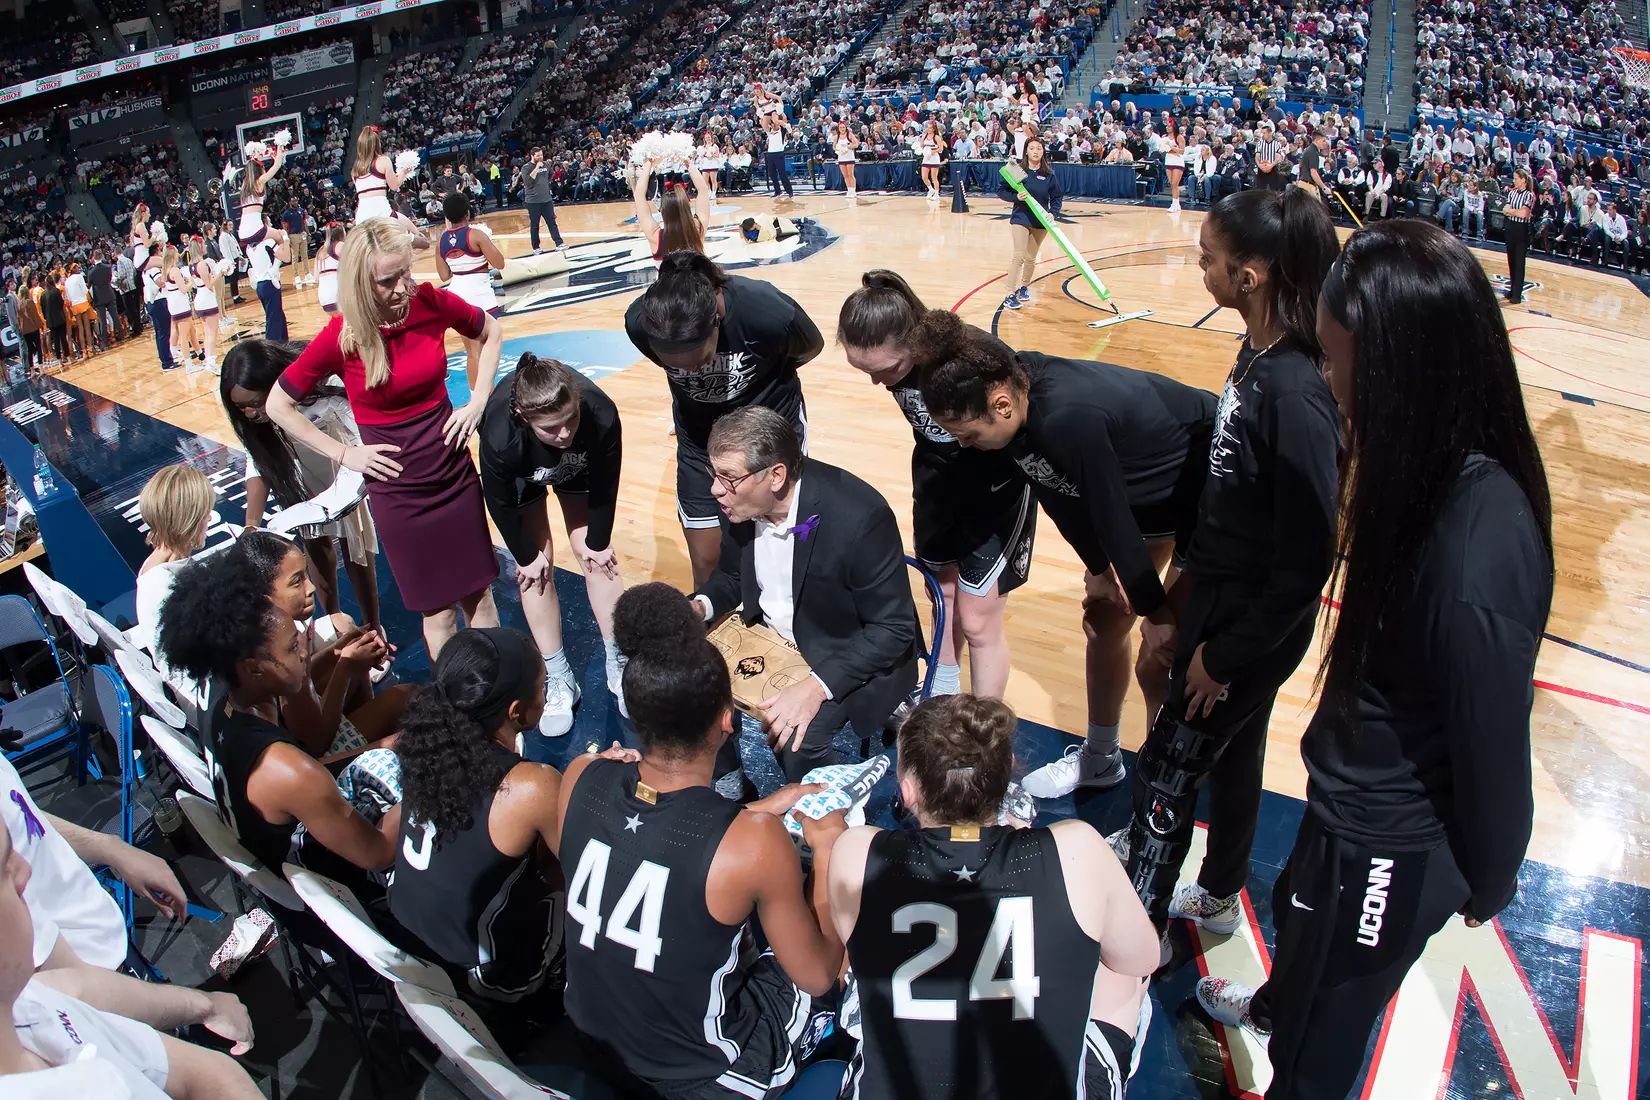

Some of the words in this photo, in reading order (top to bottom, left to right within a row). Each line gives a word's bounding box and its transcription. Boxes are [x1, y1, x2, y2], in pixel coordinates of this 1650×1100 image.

[192, 77, 228, 93] UCONN
[252, 85, 269, 95] 4:49
[120, 97, 162, 114] HUSKIES
[251, 94, 268, 111] 20
[119, 137, 131, 145] 122
[566, 837, 671, 974] 44
[1356, 857, 1395, 948] UCONN
[891, 895, 1041, 1022] 24
